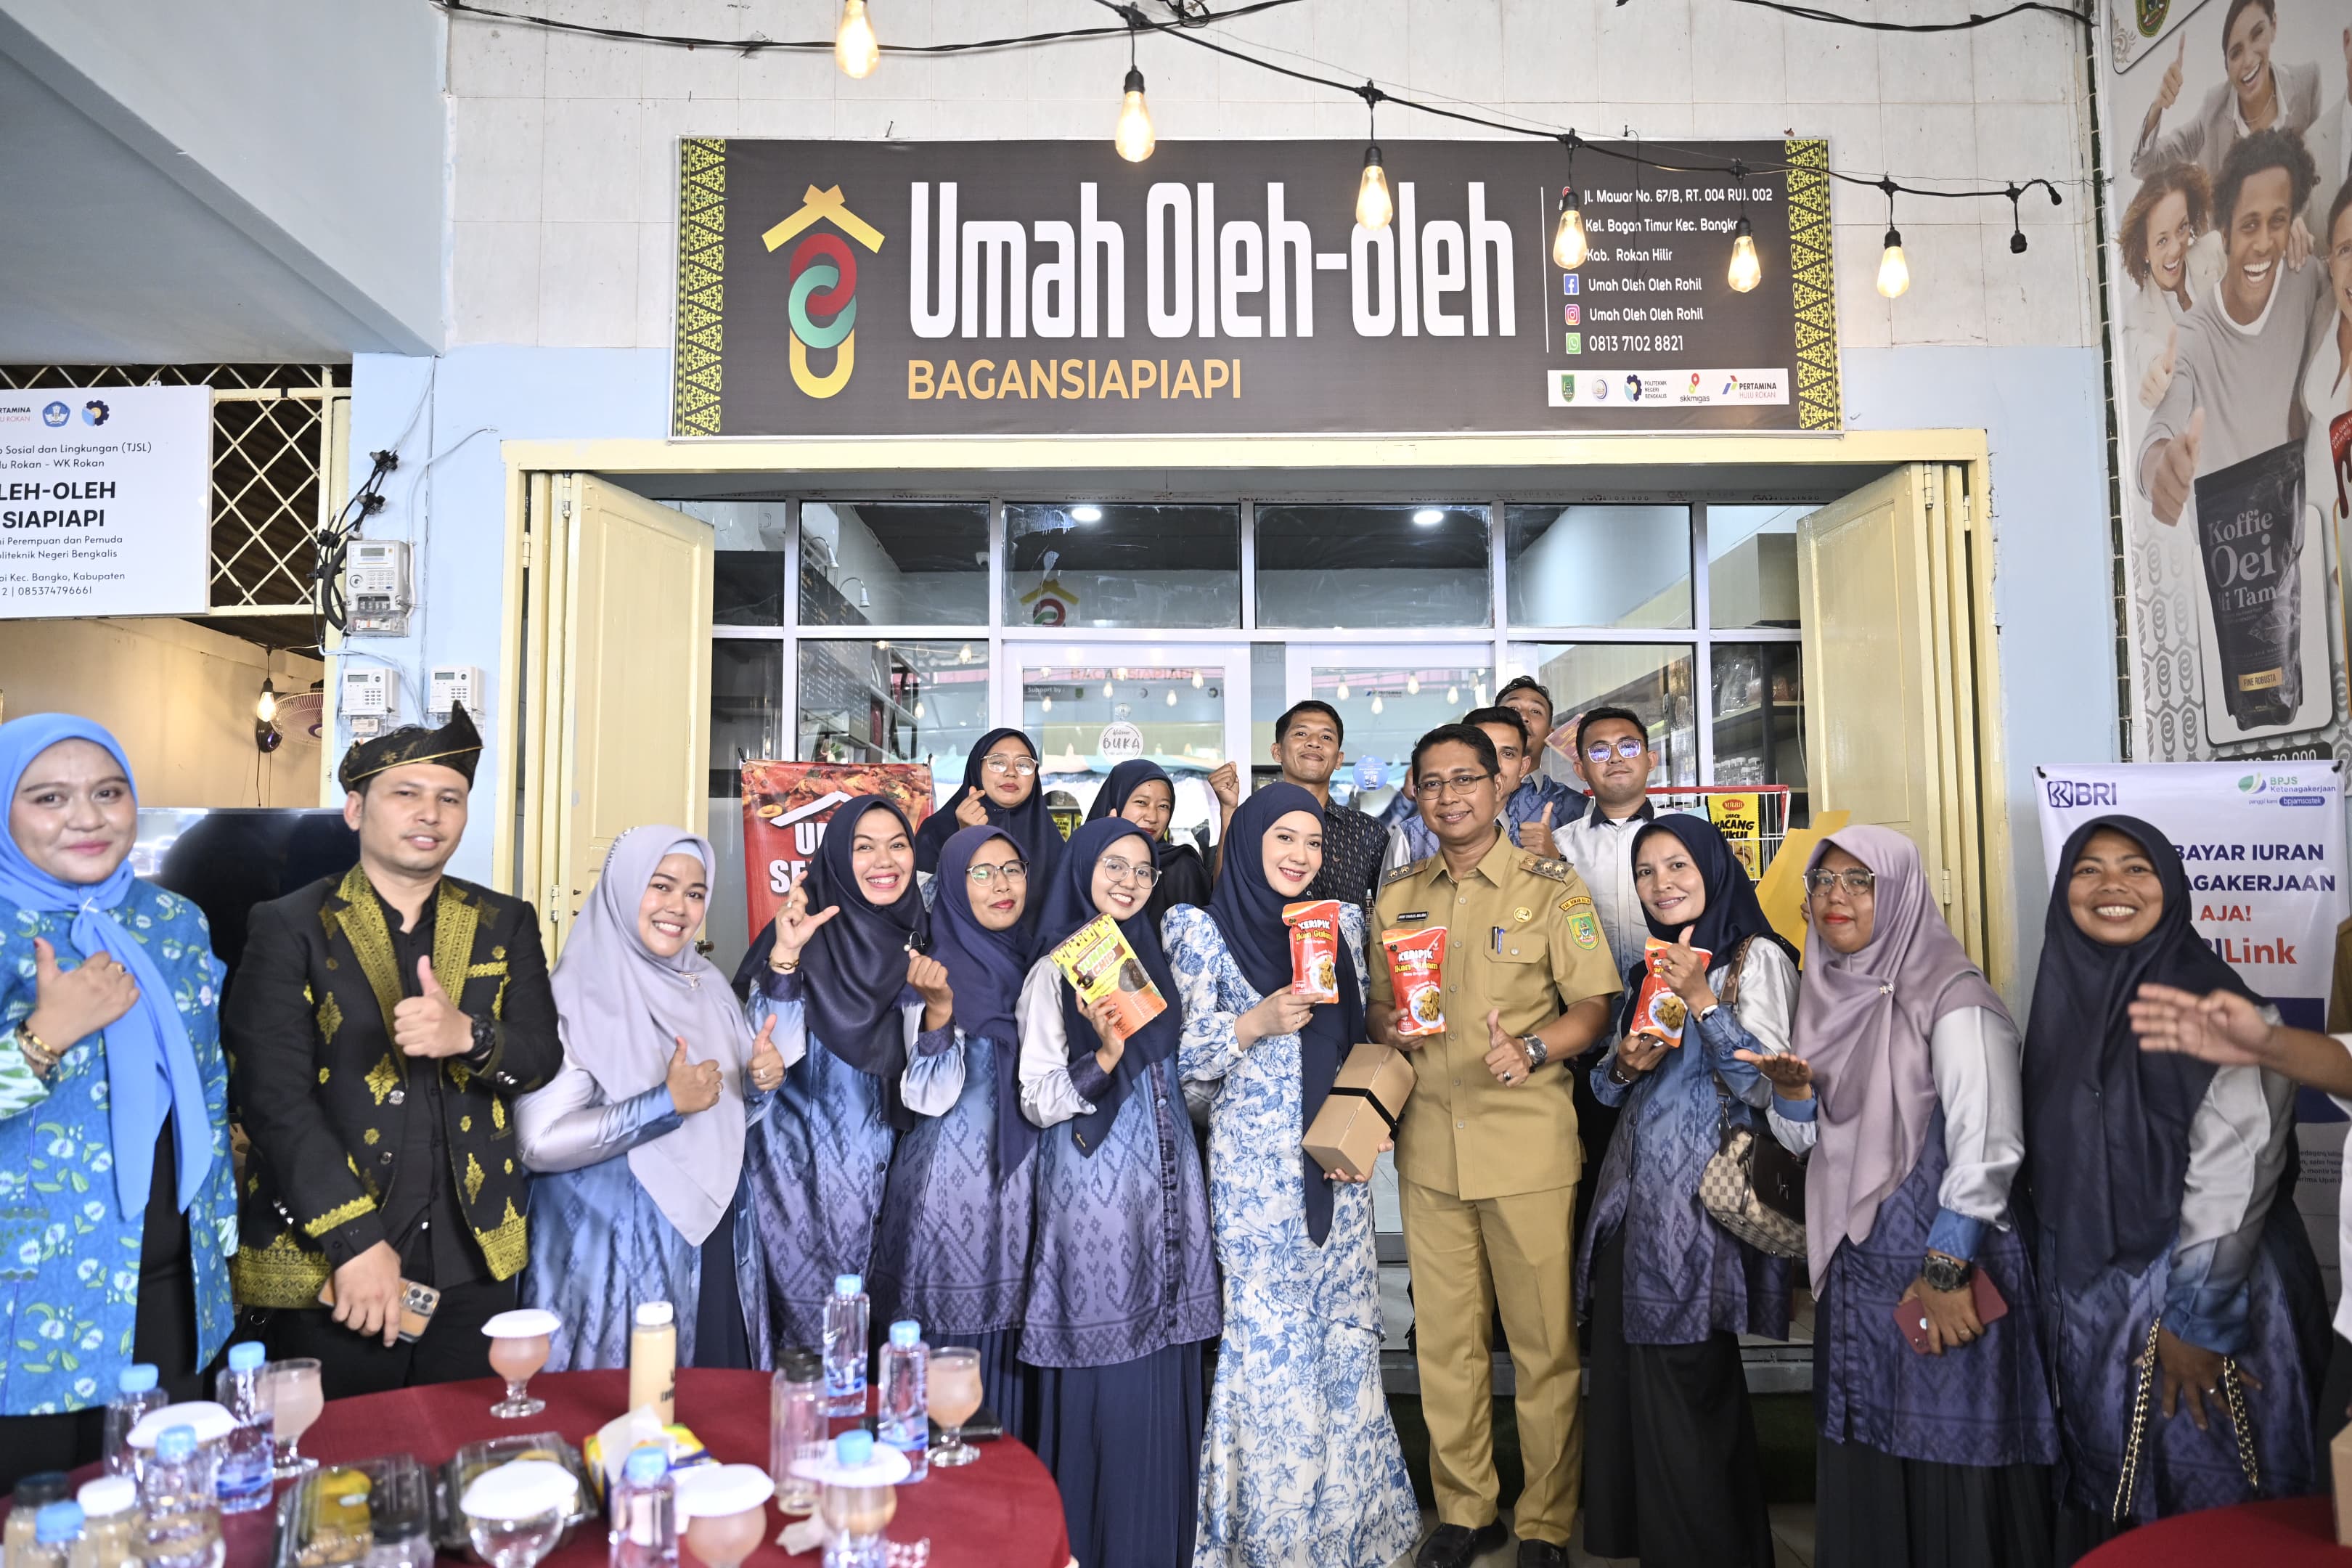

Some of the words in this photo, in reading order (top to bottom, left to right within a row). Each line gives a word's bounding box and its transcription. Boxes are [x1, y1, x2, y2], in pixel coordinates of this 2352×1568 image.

[1584, 189, 1593, 205] Jl.
[1597, 189, 1633, 203] Mawar
[1636, 189, 1653, 203] No.
[1656, 189, 1683, 204] 67/B,
[1686, 189, 1701, 203] RT.
[1705, 189, 1725, 202] 004
[1752, 188, 1773, 202] 002
[1585, 219, 1604, 232] Kel.
[1608, 219, 1641, 234] Bagan
[1644, 219, 1673, 232] Timur
[1676, 218, 1698, 232] Kec.
[910, 182, 1124, 338] Umah
[1146, 181, 1516, 338] Oleh-oleh
[1587, 248, 1609, 261] Kab.
[1616, 248, 1649, 261] Rokan
[1652, 248, 1673, 261] Hilir
[1588, 278, 1620, 292] Umah
[1622, 278, 1645, 292] Oleh
[1649, 278, 1672, 291] Oleh
[1675, 277, 1702, 291] Rohil
[1590, 308, 1620, 322] Umah
[1623, 308, 1646, 322] Oleh
[1651, 307, 1674, 321] Oleh
[1677, 307, 1704, 321] Rohil
[1589, 335, 1618, 351] 0813
[1622, 335, 1651, 351] 7102
[1654, 335, 1683, 351] 8821
[907, 359, 1241, 399] BAGANSIAPIAPI
[1739, 382, 1777, 391] PERTAMINA
[6, 444, 35, 454] Sosial
[38, 444, 57, 454] dan
[60, 444, 118, 456] Lingkungan
[121, 441, 152, 454] (TJSL)
[11, 460, 41, 469] Rokan
[53, 459, 70, 467] WK
[73, 459, 105, 467] Rokan
[2, 509, 105, 528] SIAPIAPI
[2207, 509, 2274, 546] Koffie
[7, 536, 61, 547] Perempuan
[63, 536, 82, 544] dan
[85, 535, 123, 544] Pemuda
[38, 550, 69, 560] Negeri
[72, 549, 118, 560] Bengkalis
[2210, 534, 2277, 588] Oei
[10, 573, 29, 582] Kec.
[32, 572, 70, 584] Bangko,
[73, 571, 126, 583] Kabupaten
[2234, 586, 2279, 608] Tam
[2243, 677, 2254, 687] FINE
[1103, 737, 1140, 749] BUKA
[2270, 777, 2298, 785] BPJS
[2075, 783, 2118, 806] BRI
[2270, 785, 2336, 793] Ketenagakerjaan
[1714, 820, 1755, 830] KACANG
[2252, 844, 2324, 861] IURAN
[2200, 905, 2252, 921] AJA!
[1398, 949, 1434, 962] KERIPIK
